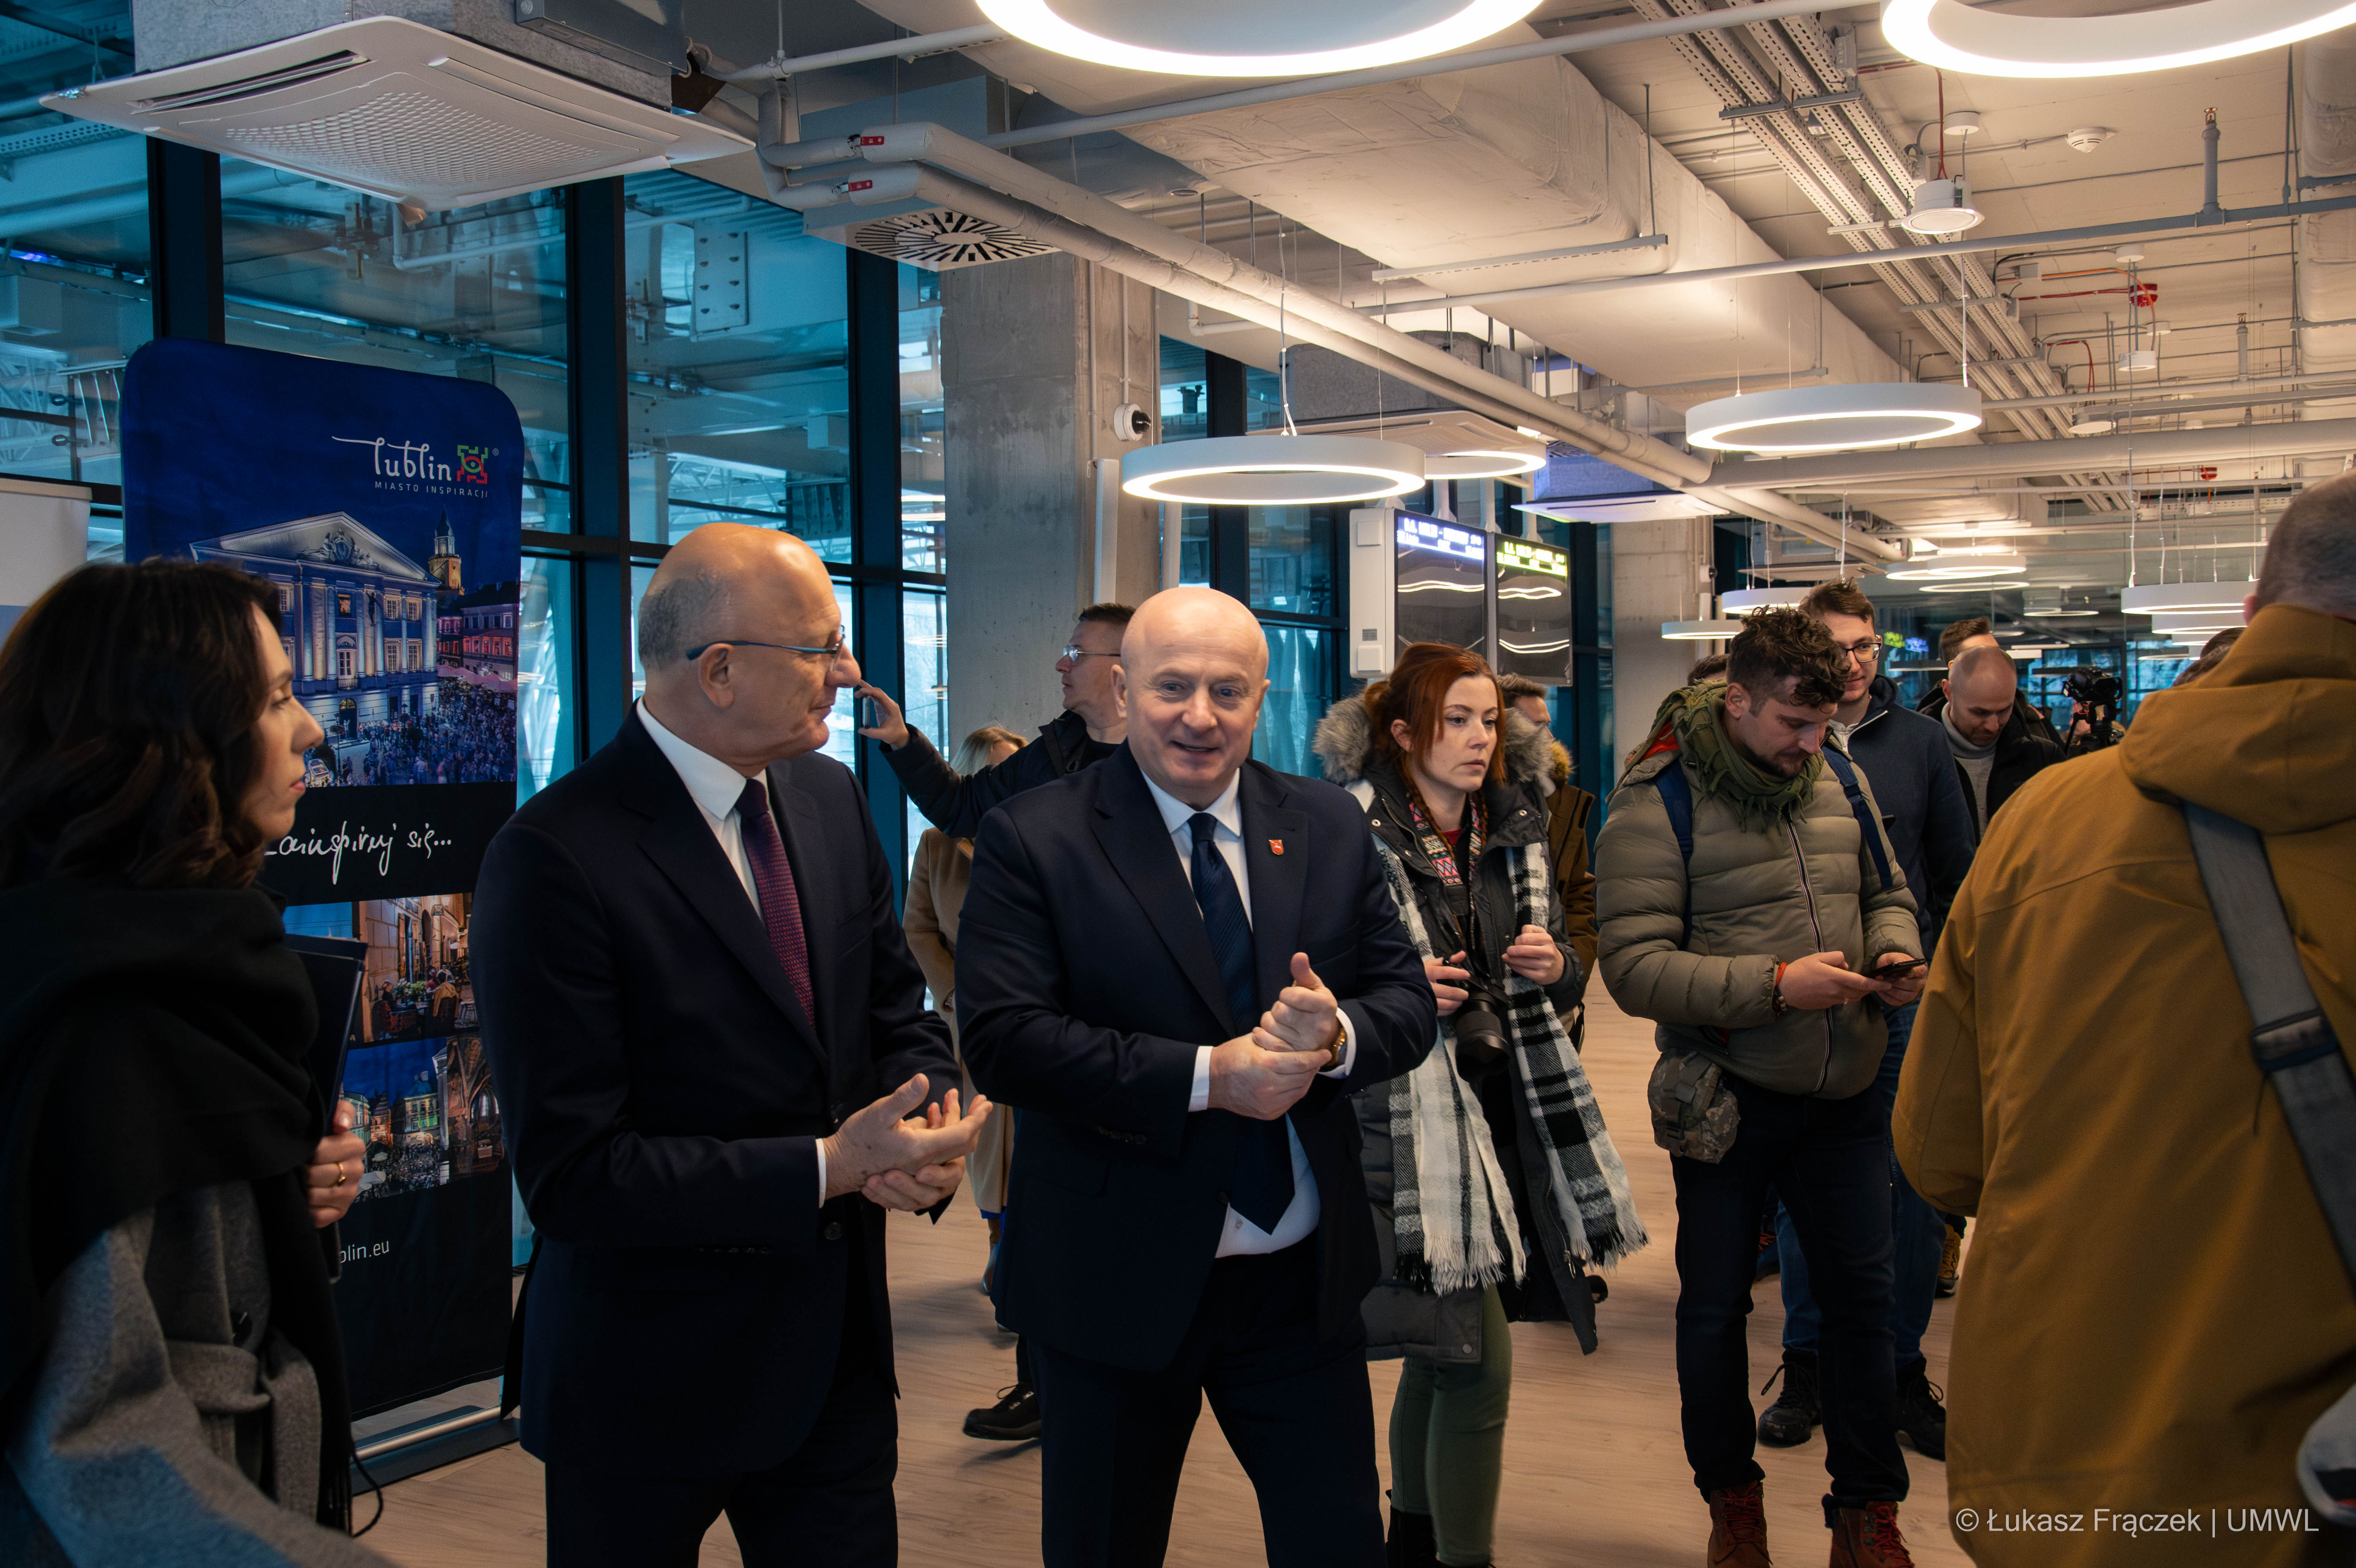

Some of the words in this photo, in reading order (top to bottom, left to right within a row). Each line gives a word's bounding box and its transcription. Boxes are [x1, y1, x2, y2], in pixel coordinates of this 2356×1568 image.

[375, 481, 419, 492] MIASTO
[426, 485, 488, 498] INSPIRACJI
[264, 821, 396, 885] ainspiruj
